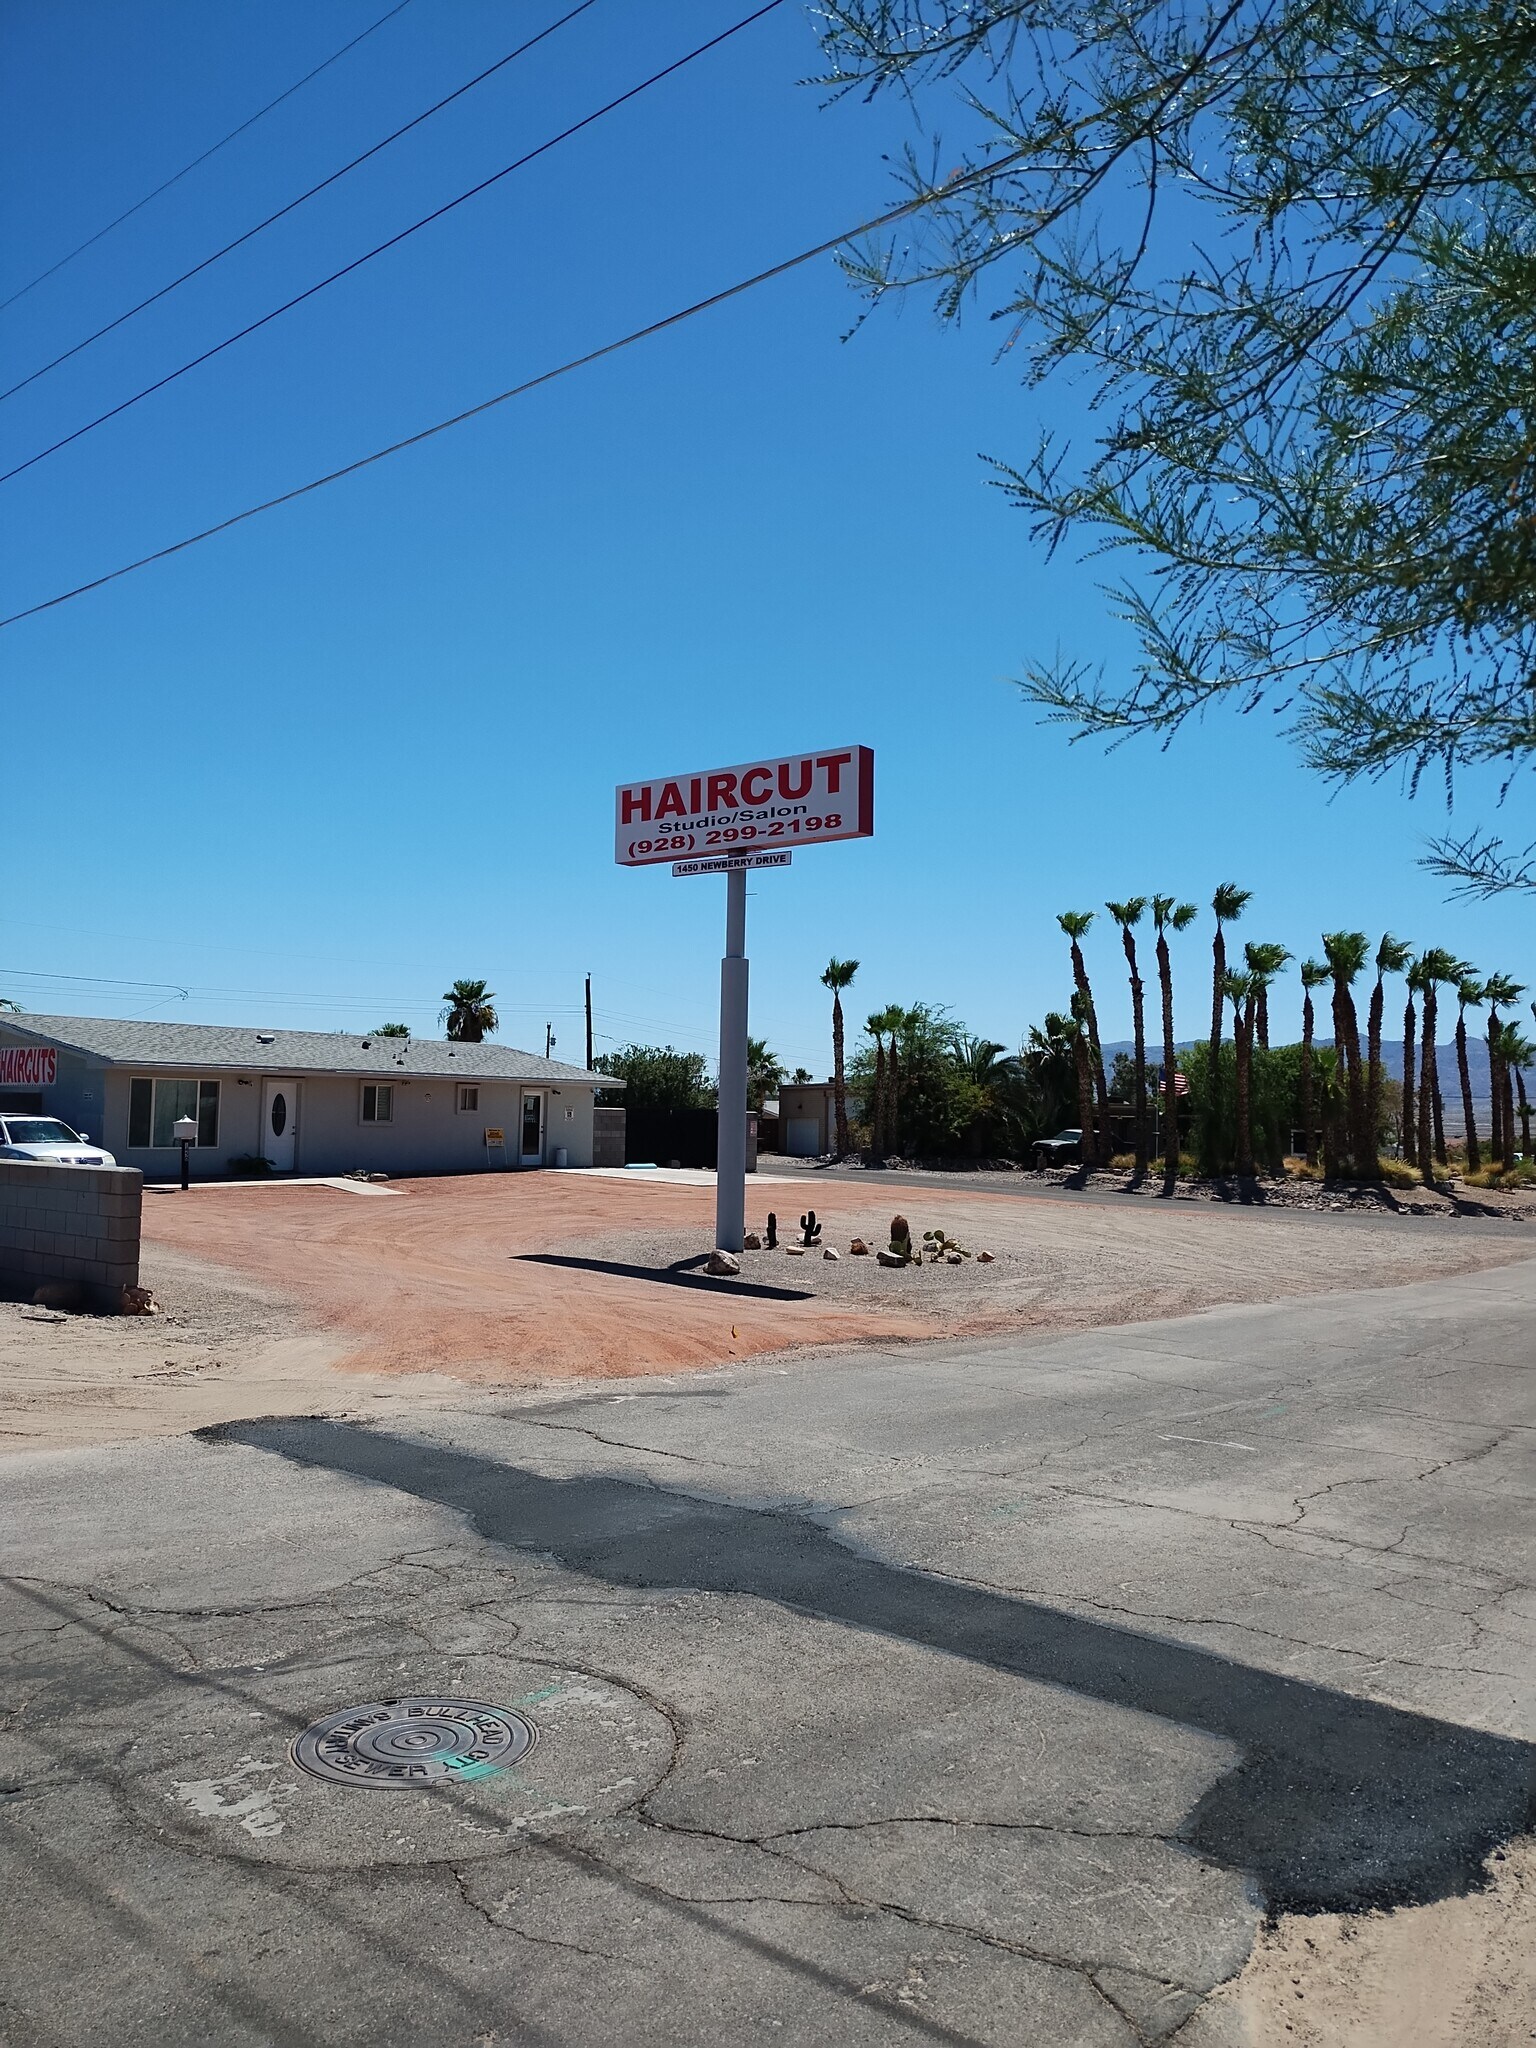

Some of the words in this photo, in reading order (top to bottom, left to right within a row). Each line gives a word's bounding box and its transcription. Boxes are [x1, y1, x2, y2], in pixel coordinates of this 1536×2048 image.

[621, 752, 851, 825] HAIRCUT
[628, 834, 696, 858] (928)
[705, 813, 843, 845] 299-2198
[658, 805, 808, 834] Studio/Salon
[677, 863, 699, 874] 1450
[700, 858, 753, 871] NEWBERRY
[755, 854, 787, 866] DRIVE
[0, 1048, 55, 1083] HAIRCUTS
[407, 1707, 504, 1746] BULLHEAD
[334, 1754, 428, 1777] SEWER
[442, 1749, 490, 1773] CITY
